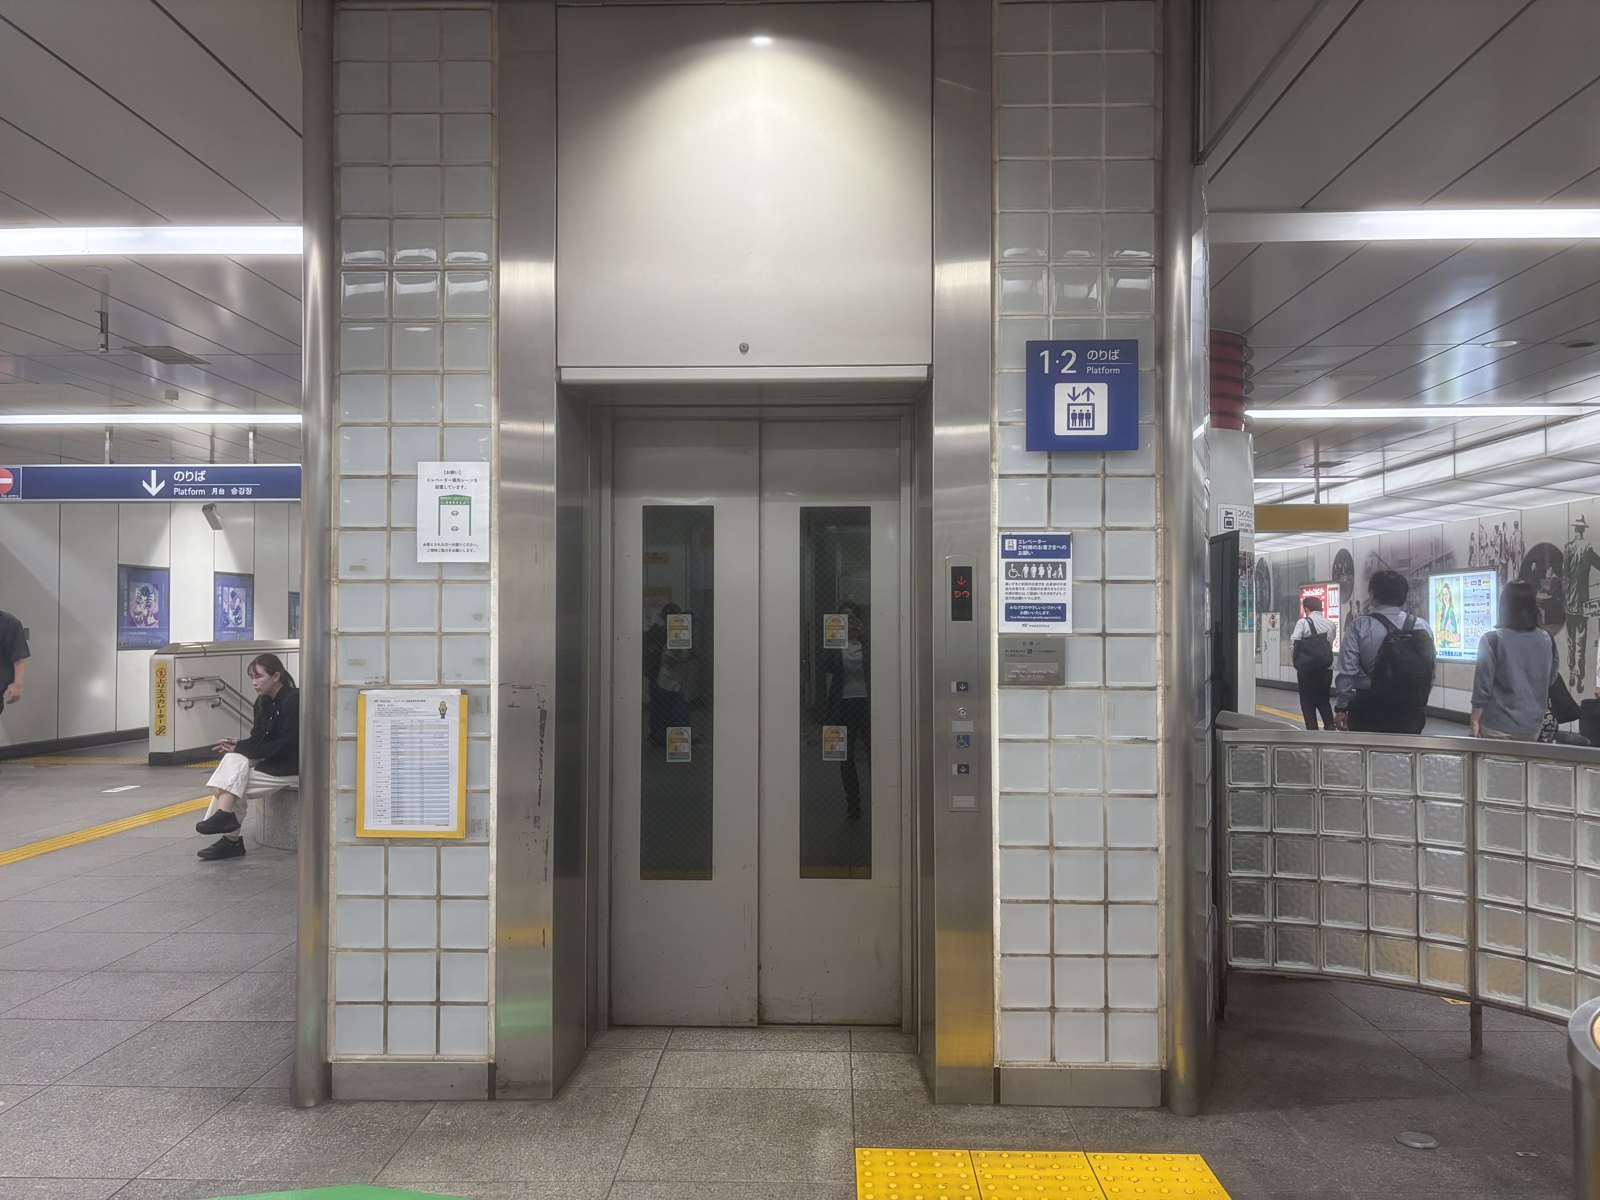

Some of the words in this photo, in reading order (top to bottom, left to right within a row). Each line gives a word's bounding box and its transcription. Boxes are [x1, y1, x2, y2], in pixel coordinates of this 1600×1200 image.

[1087, 349, 1120, 361] のりば
[1086, 366, 1120, 375] Platform
[173, 470, 206, 482] のりば
[173, 487, 206, 496] Platform
[211, 487, 225, 496] 月台
[230, 487, 253, 496] 승강장
[156, 678, 166, 725] 上りエスカレーター
